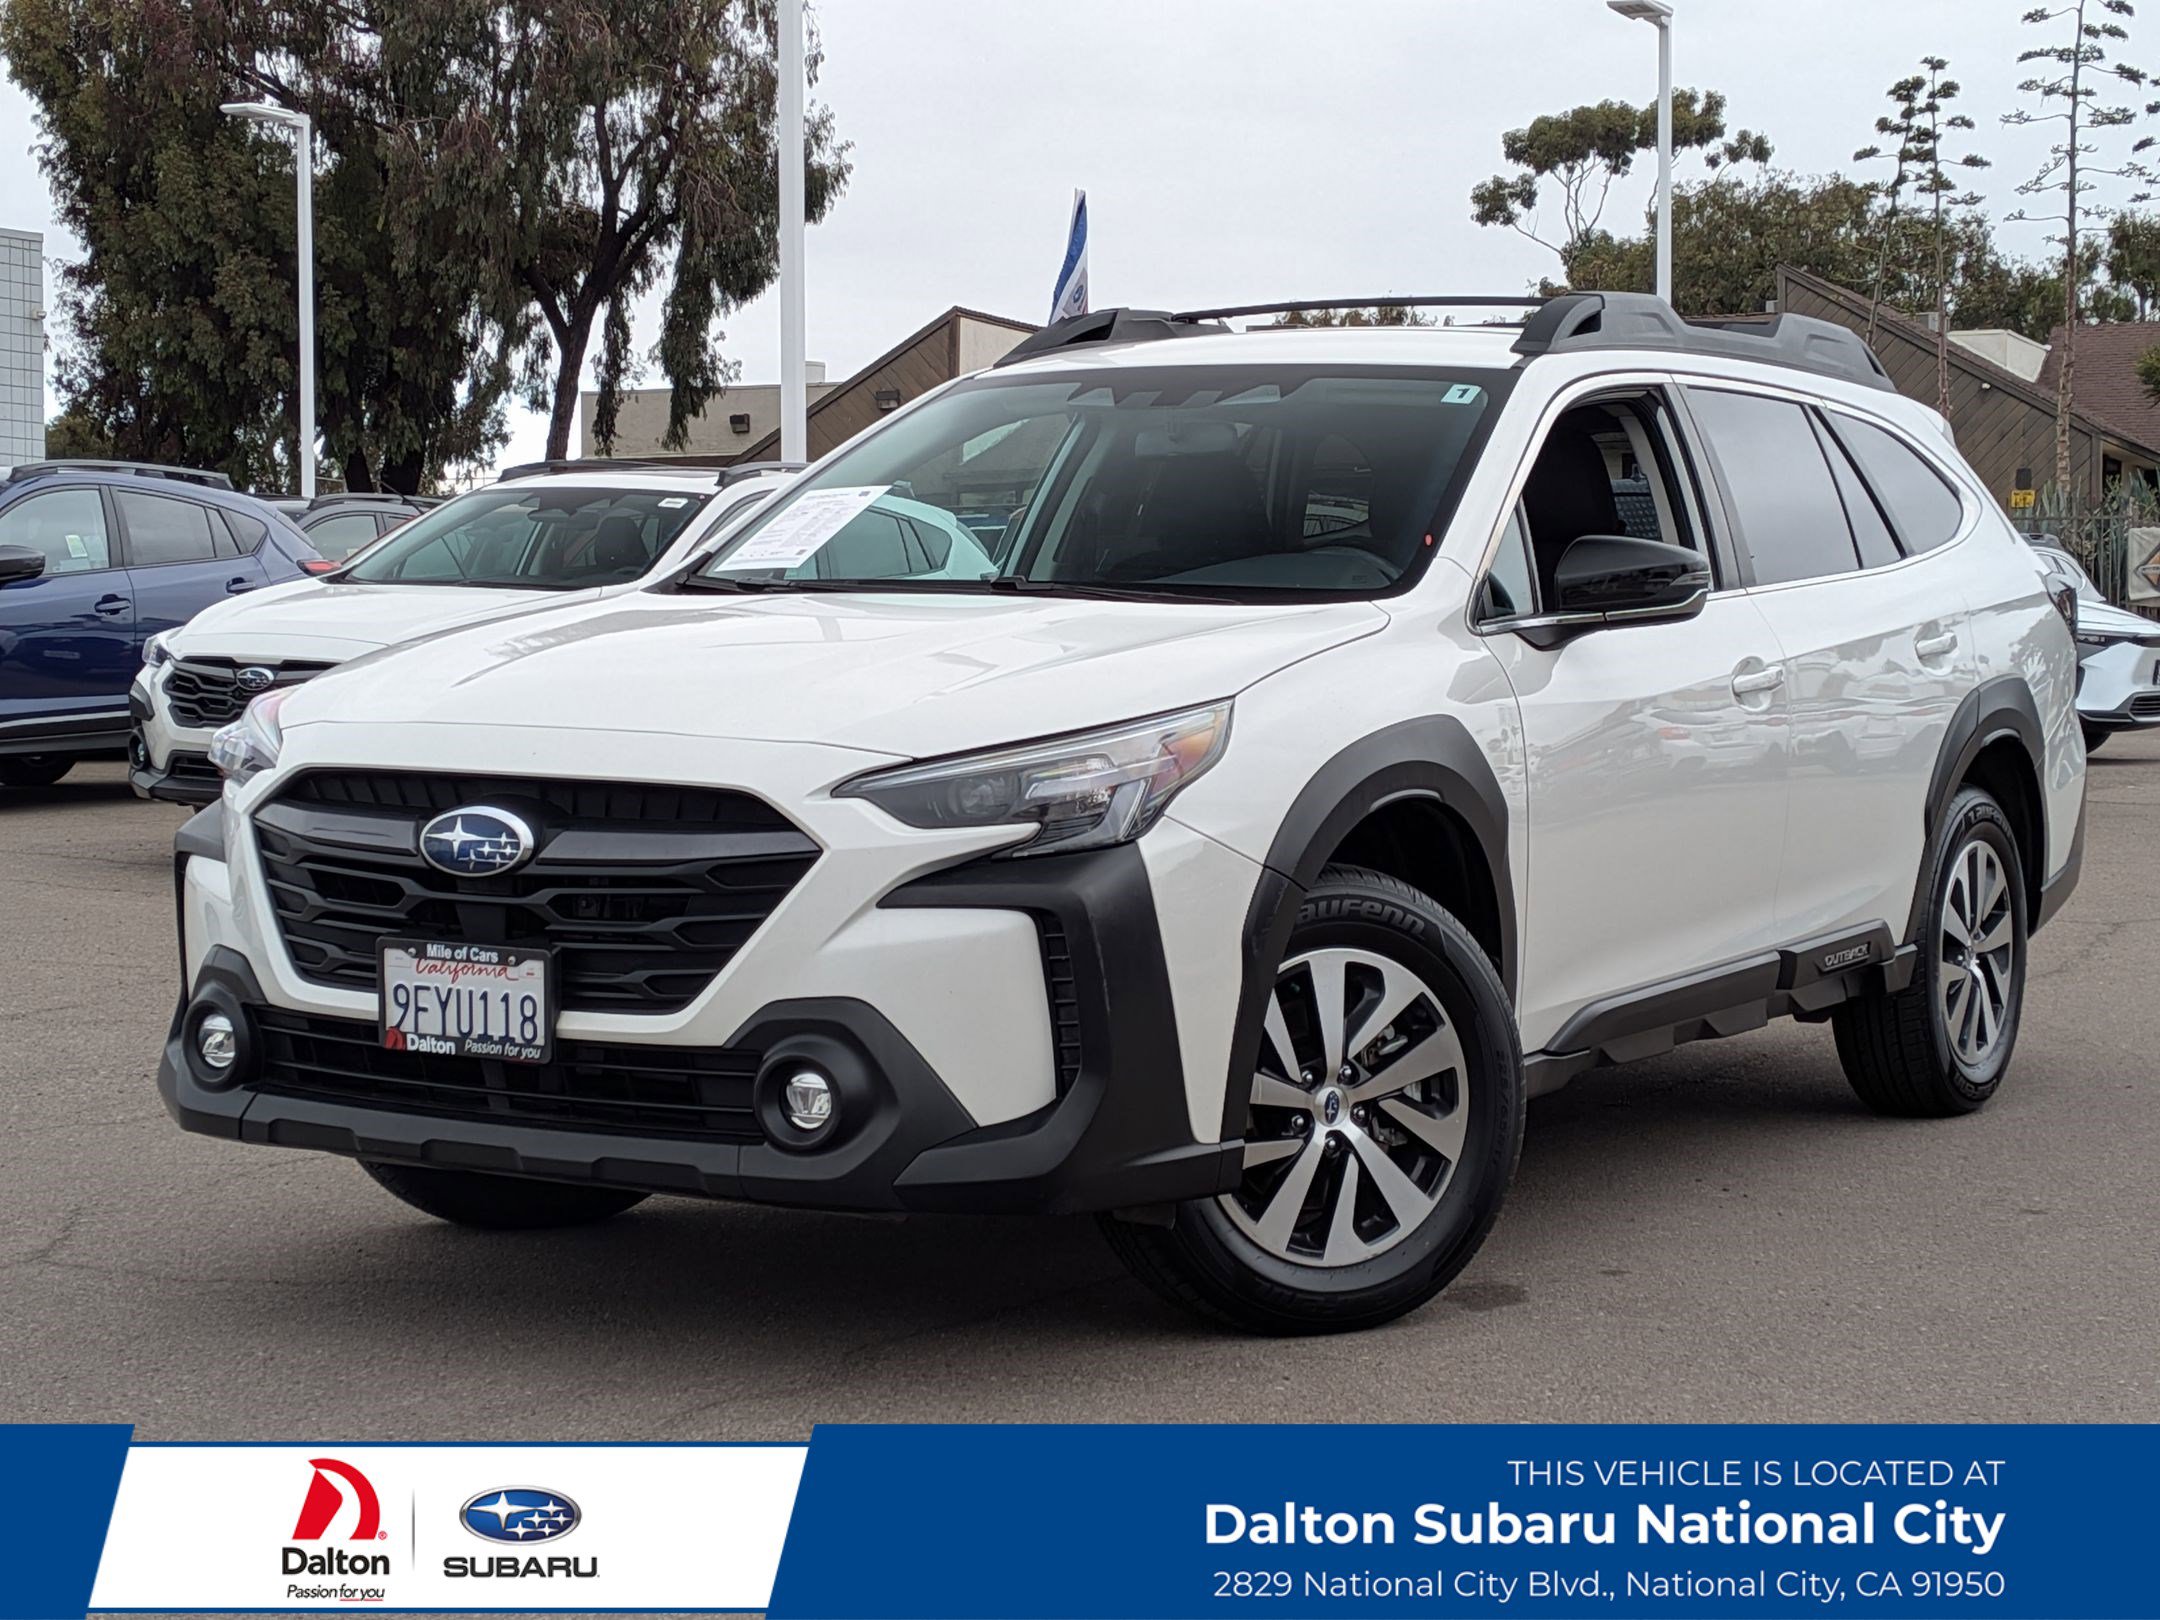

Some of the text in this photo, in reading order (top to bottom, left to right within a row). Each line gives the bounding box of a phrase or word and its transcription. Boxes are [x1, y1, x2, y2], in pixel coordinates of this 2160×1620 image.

[1456, 387, 1471, 400] 1
[1296, 898, 1426, 938] aufenn
[426, 943, 499, 963] Mile of Cars
[1824, 942, 1869, 967] OUTBACK
[415, 957, 519, 984] California
[392, 983, 538, 1045] 9FYU118
[406, 1033, 541, 1060] Dalton Passion for you
